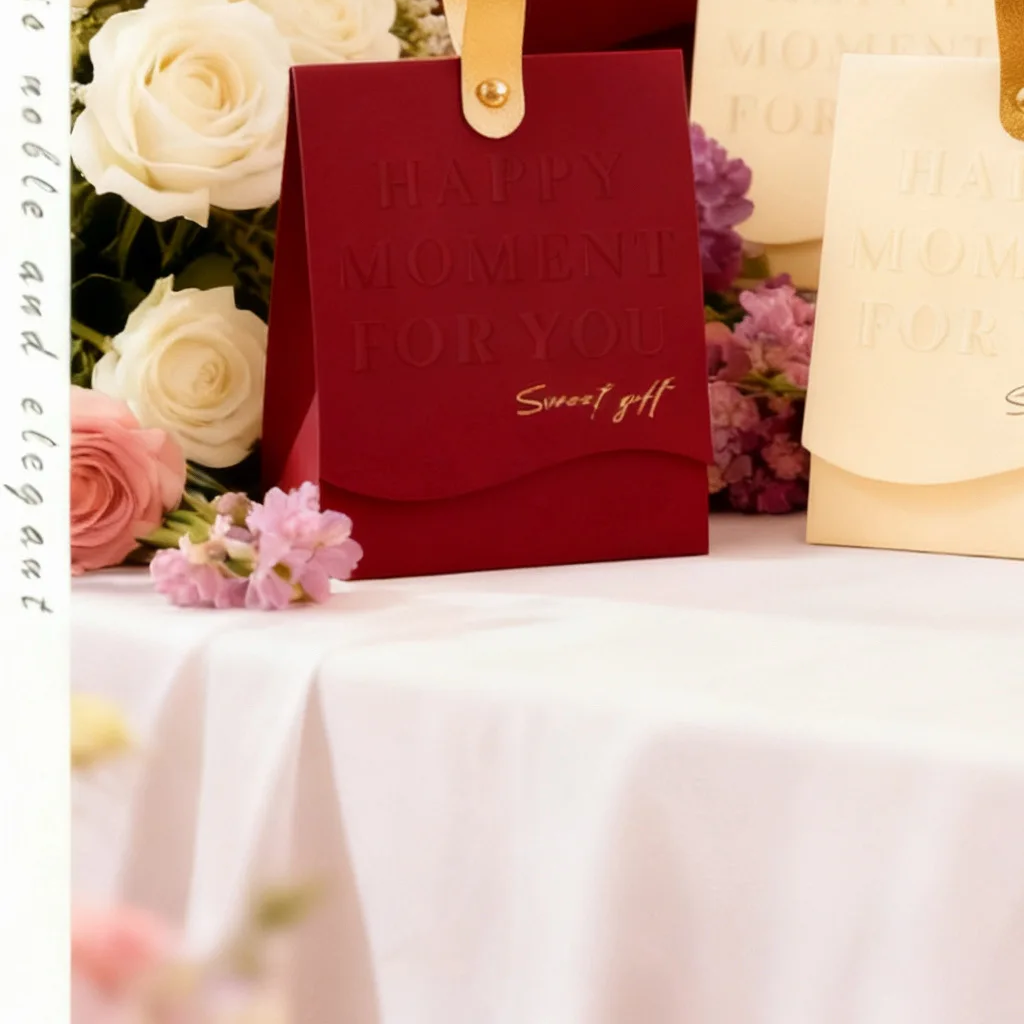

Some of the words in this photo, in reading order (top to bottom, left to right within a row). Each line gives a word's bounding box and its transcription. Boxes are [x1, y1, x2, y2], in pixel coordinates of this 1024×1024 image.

[372, 150, 624, 210] HAPPY
[338, 228, 676, 290] MOMENT
[349, 312, 500, 374] FOR
[517, 304, 668, 363] YOU
[854, 299, 1000, 358] FOR
